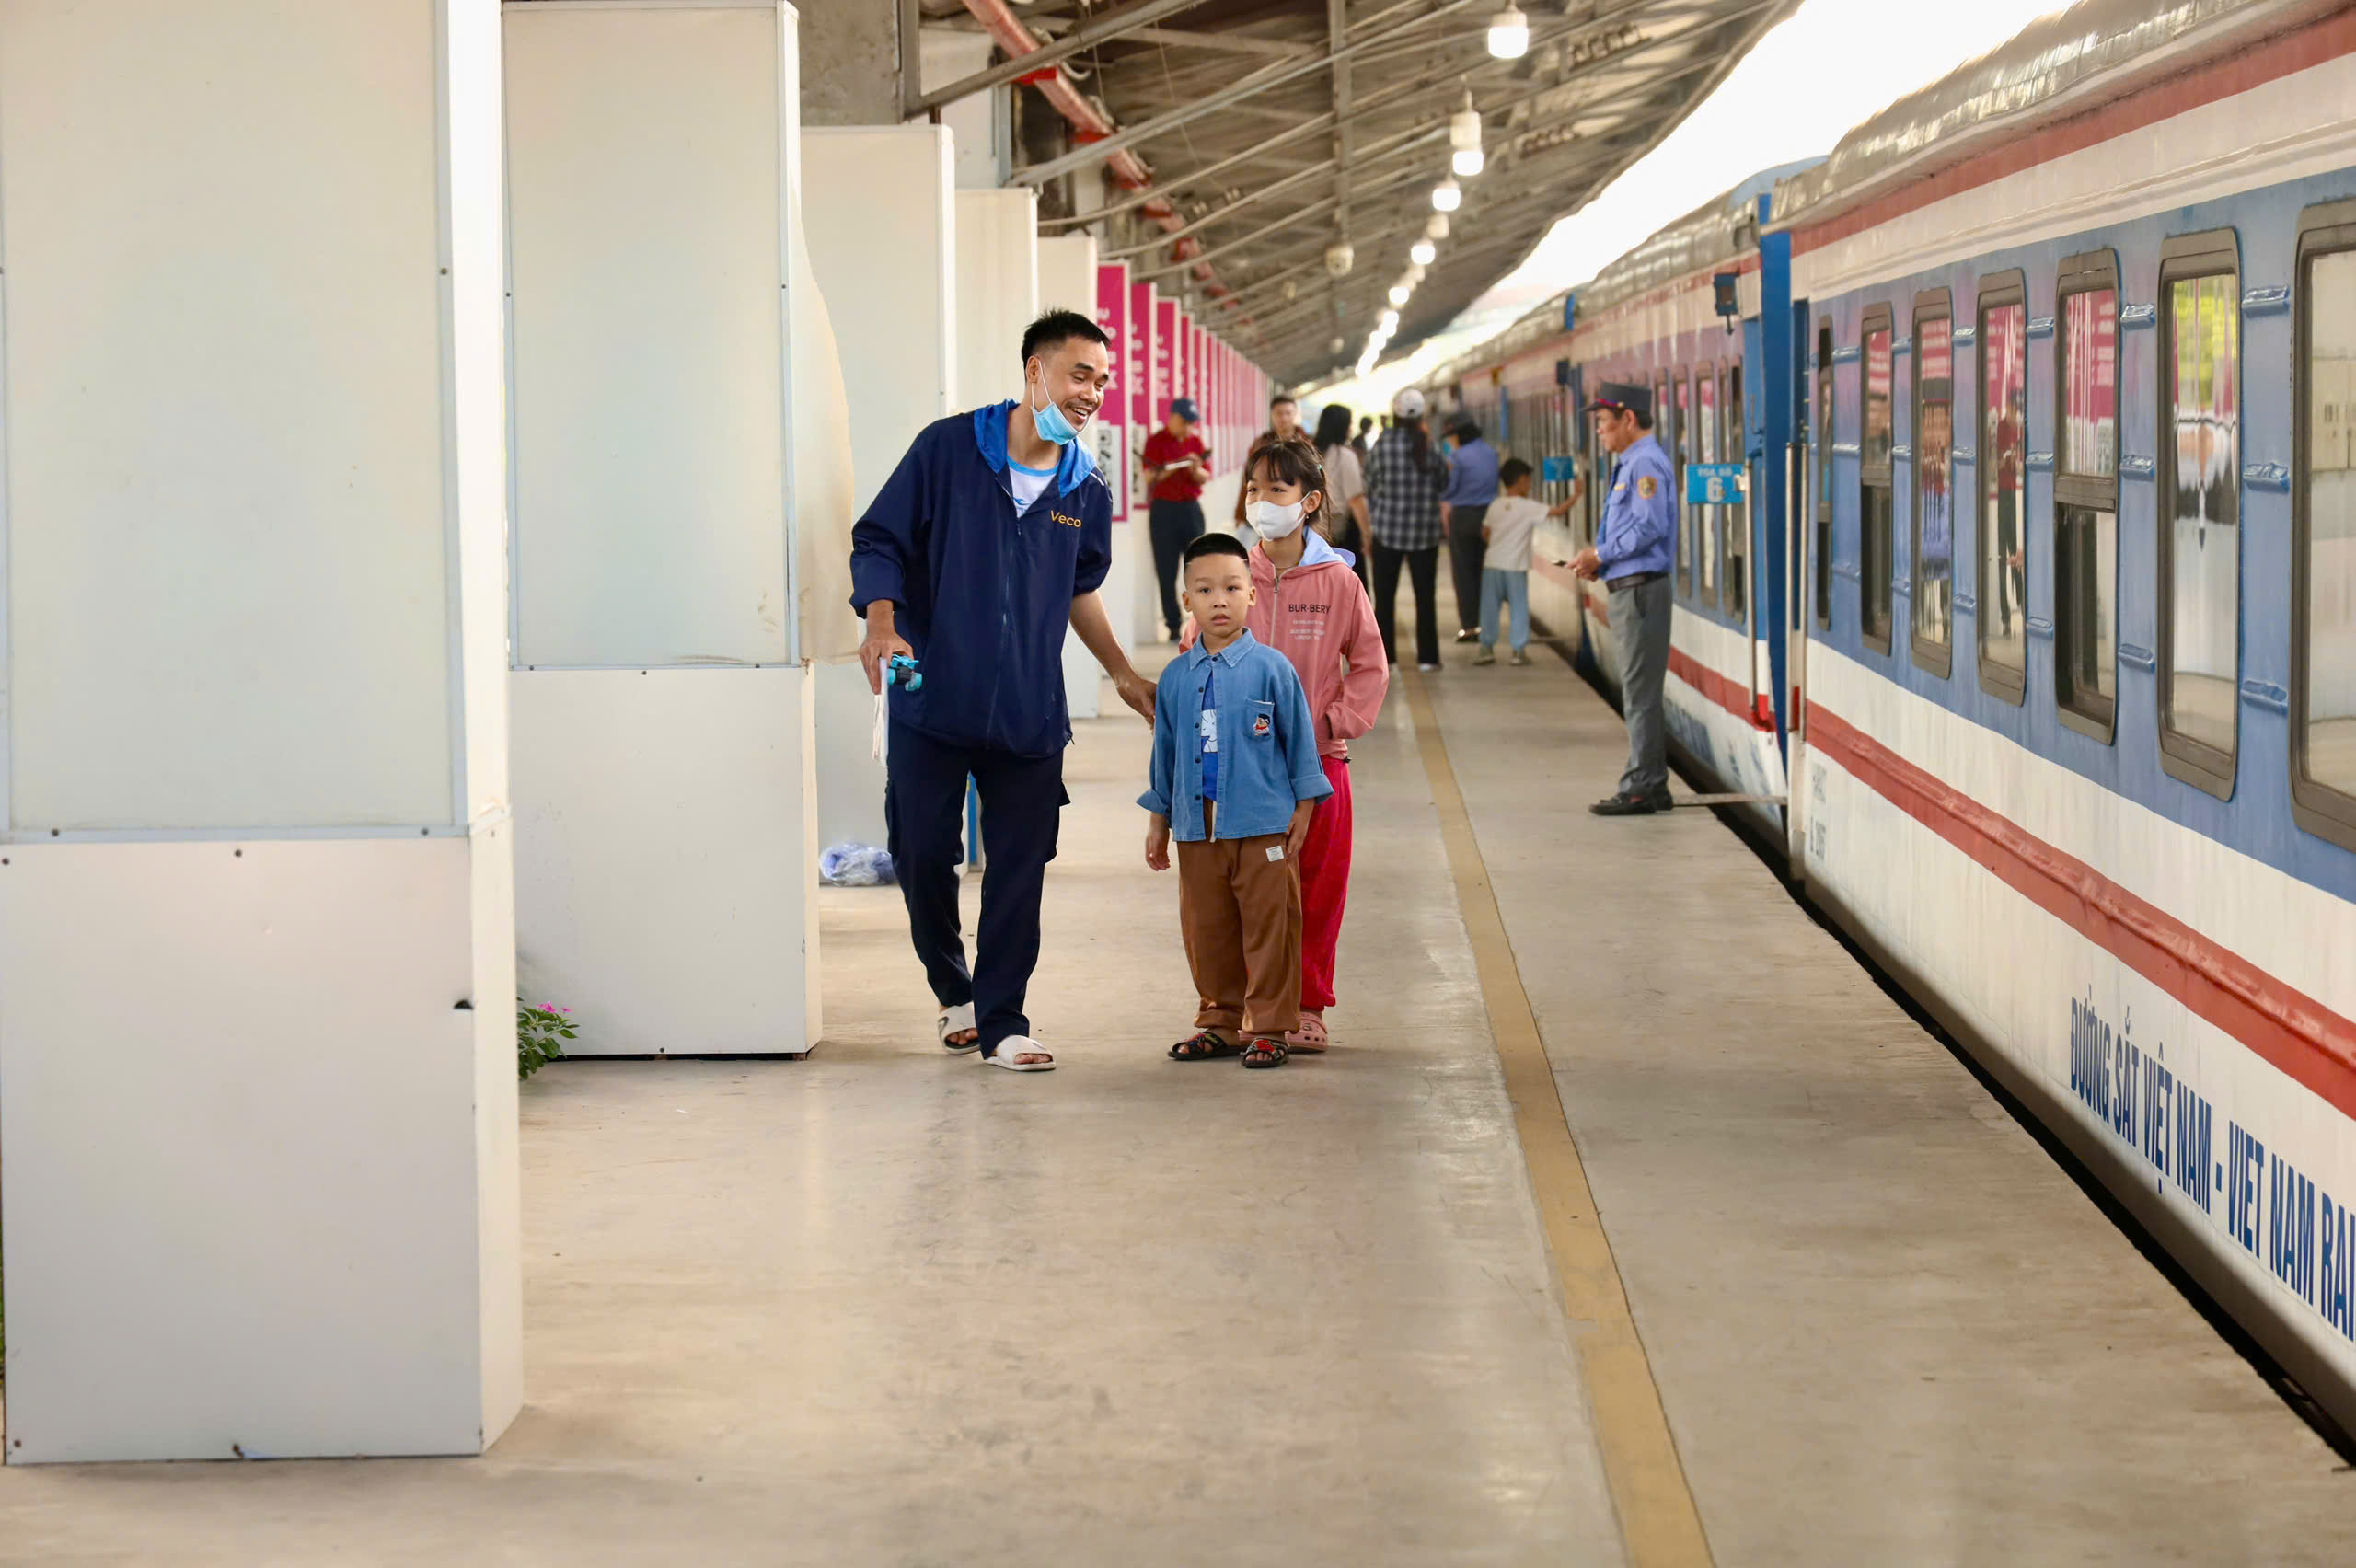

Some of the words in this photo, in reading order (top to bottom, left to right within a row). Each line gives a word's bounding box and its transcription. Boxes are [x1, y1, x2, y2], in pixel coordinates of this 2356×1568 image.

[1707, 477, 1723, 502] 6
[1050, 509, 1082, 528] Veco
[2071, 983, 2111, 1124] ĐƯỜNG
[2113, 1005, 2140, 1148] SẮT
[2143, 1041, 2173, 1195] VIỆT
[2177, 1079, 2212, 1216] NAM
[2215, 1161, 2223, 1193] -
[2229, 1119, 2265, 1260] VIET
[2269, 1152, 2315, 1308] NAM
